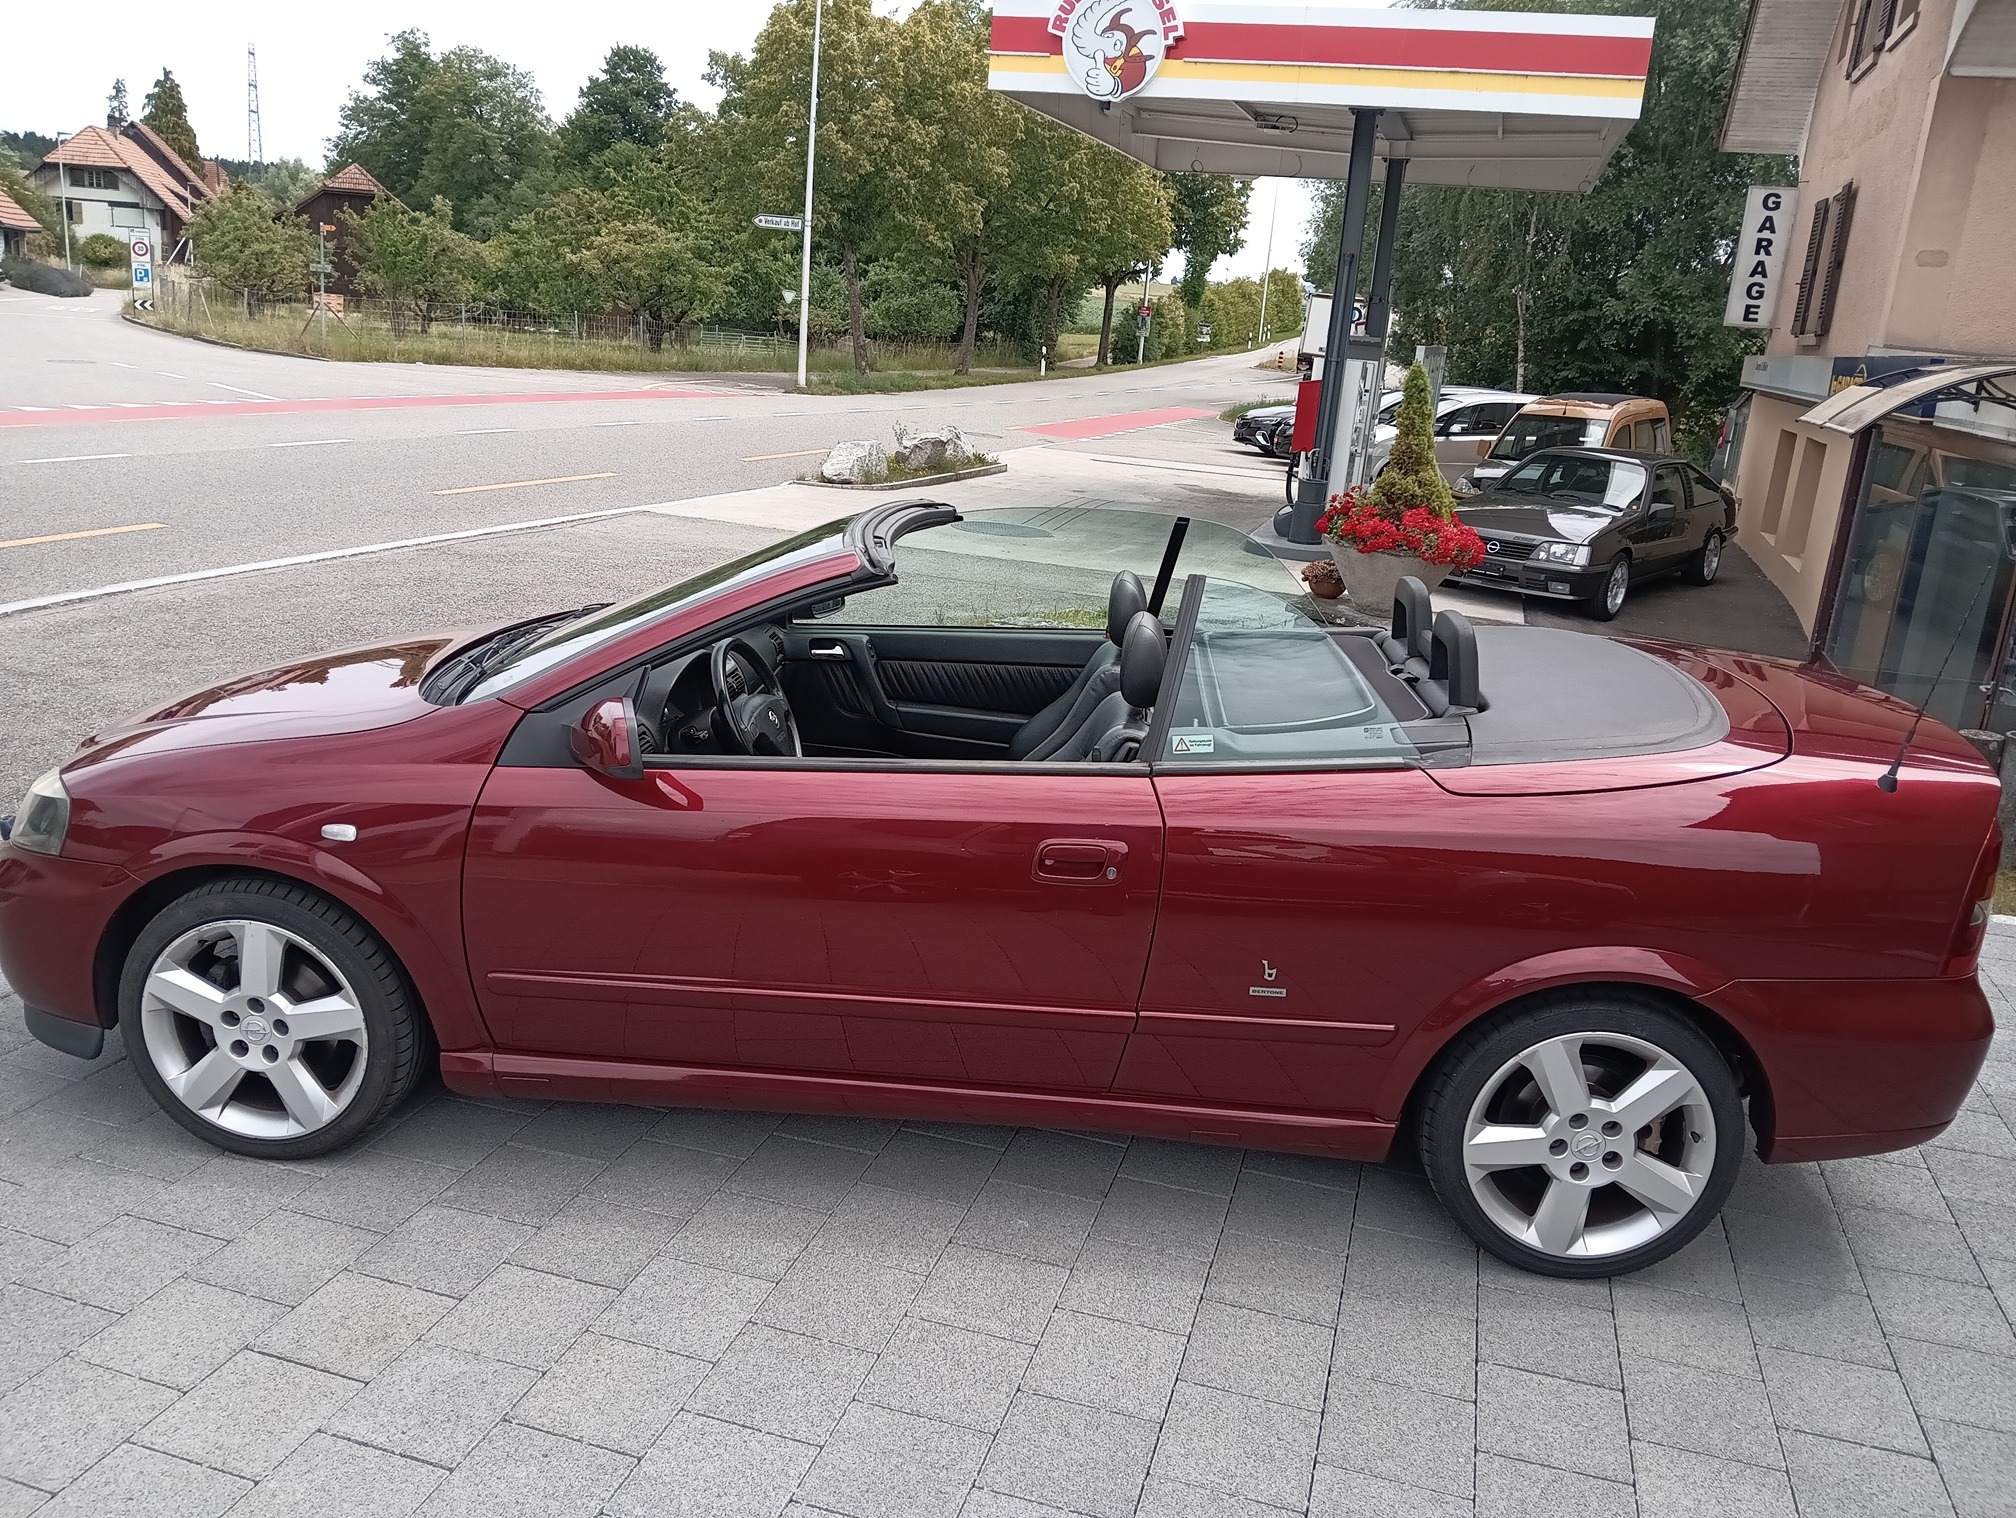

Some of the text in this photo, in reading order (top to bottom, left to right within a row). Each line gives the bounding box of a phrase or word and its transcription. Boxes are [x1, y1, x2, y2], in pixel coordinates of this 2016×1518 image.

[1052, 0, 1179, 41] RU SEL
[763, 217, 800, 228] Verkauf ab Hof
[1742, 192, 1782, 322] GARAGE
[136, 269, 145, 281] P
